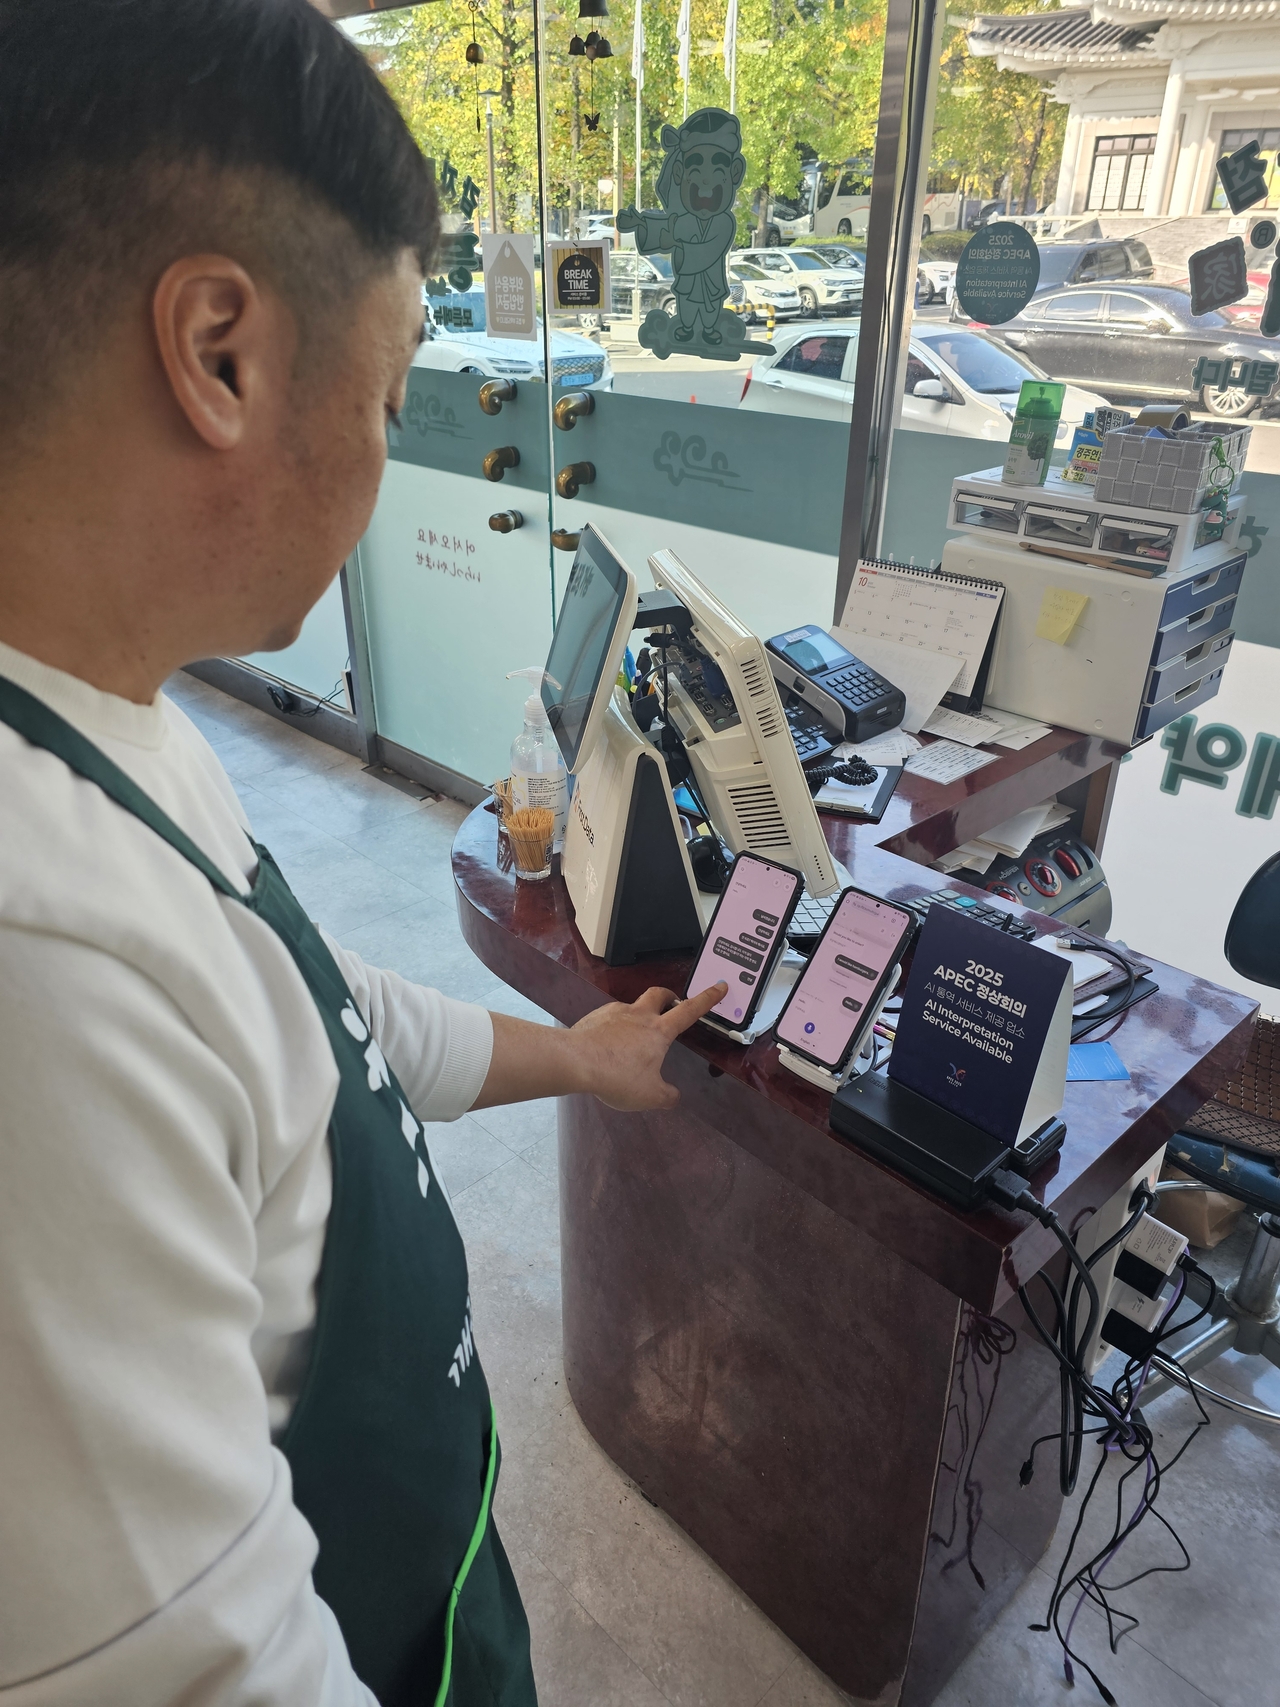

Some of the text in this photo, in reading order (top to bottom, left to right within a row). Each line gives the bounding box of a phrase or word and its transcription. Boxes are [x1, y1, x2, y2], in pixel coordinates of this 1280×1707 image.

[564, 269, 592, 279] BREAK
[568, 280, 589, 289] TIME
[859, 577, 868, 586] 10
[934, 964, 1027, 1018] APEC 정상회의
[965, 960, 1004, 986] 2025
[924, 982, 1025, 1039] AI 통역 서비스 제공 업소
[925, 998, 1014, 1051] AI Interpretation
[922, 1010, 1013, 1064] Service Available
